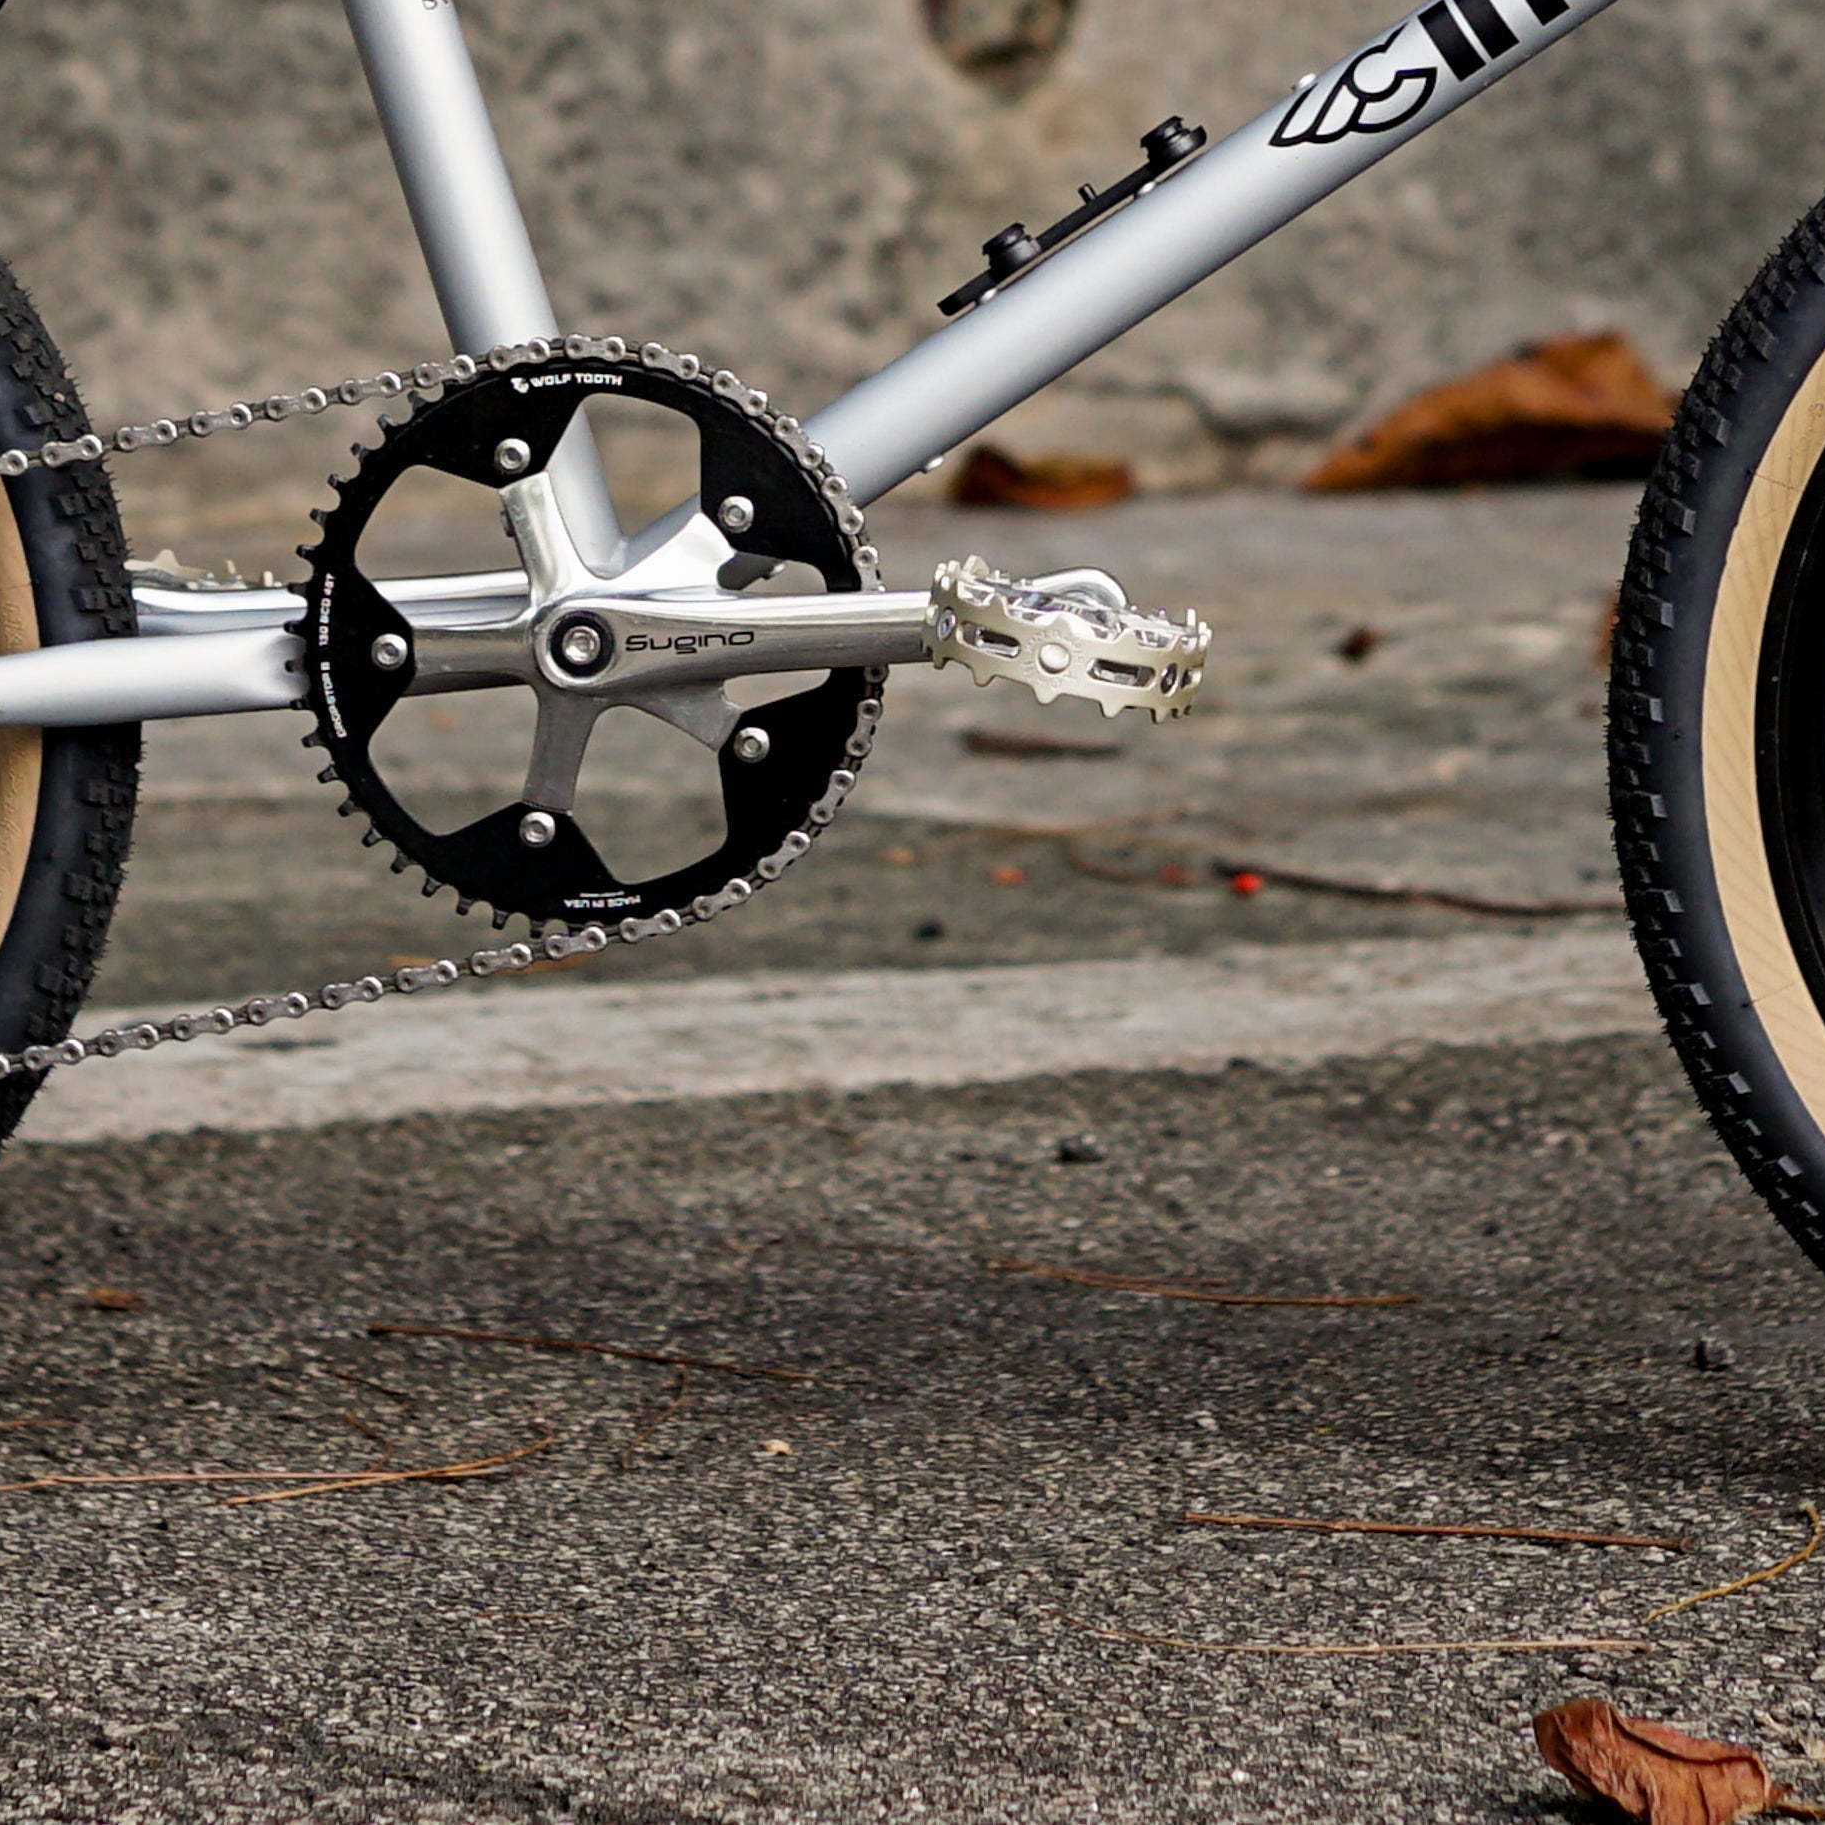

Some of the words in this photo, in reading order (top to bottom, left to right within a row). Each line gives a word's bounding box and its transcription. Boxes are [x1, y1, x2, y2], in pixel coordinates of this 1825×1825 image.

[529, 373, 572, 387] WOLF
[575, 373, 623, 387] TOOTH
[319, 598, 332, 623] BCD
[625, 631, 755, 655] Sugino
[563, 899, 590, 908] USA
[607, 895, 641, 908] MADE
